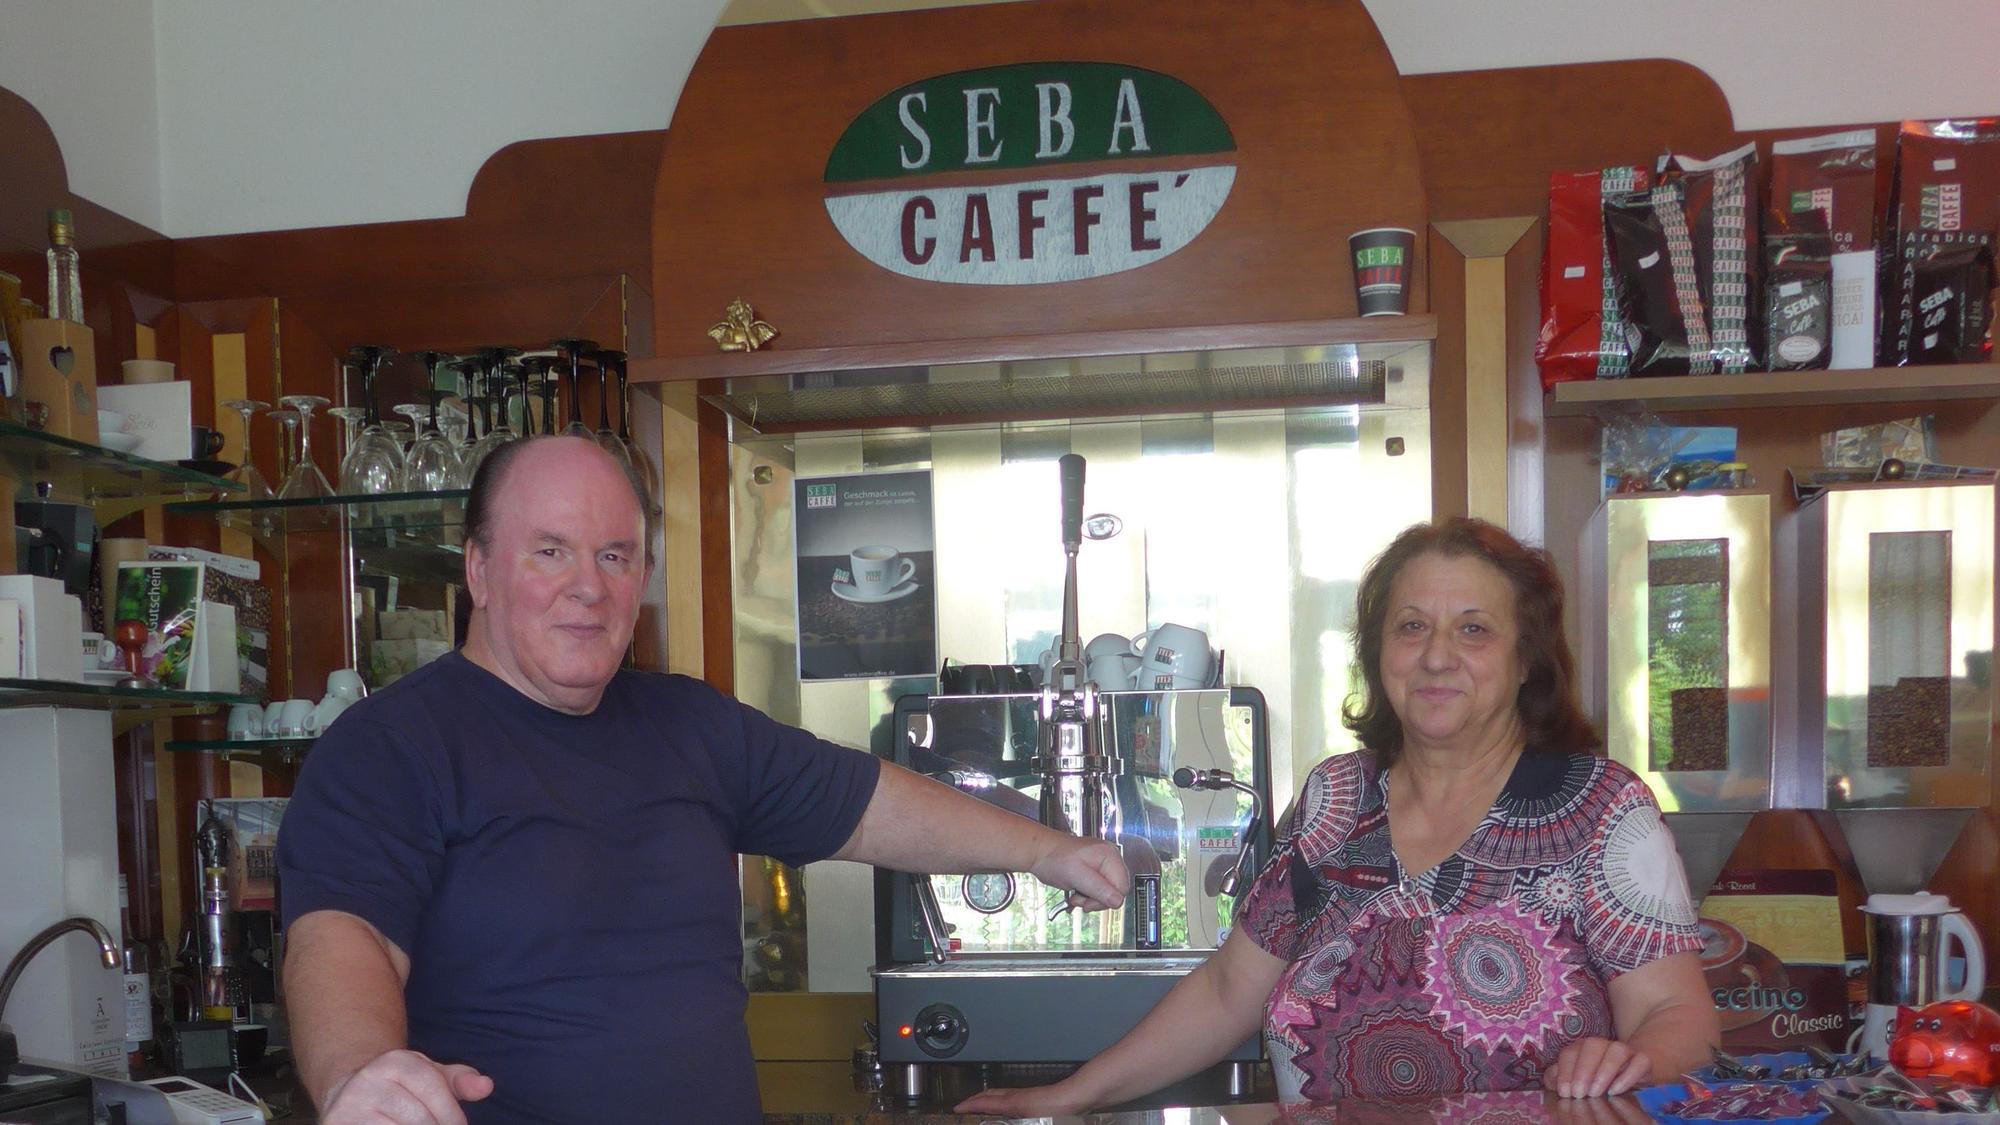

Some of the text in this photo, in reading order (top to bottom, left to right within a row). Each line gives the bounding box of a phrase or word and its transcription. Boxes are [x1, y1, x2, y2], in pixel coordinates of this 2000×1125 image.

[899, 78, 1151, 170] SEBA
[1922, 186, 1939, 230] SEBA
[1905, 232, 1988, 245] Arabica
[1357, 248, 1401, 267] SEBA
[1783, 294, 1820, 319] SEBA
[1920, 288, 1953, 313] SEBA
[843, 490, 889, 500] Geschmack
[148, 567, 161, 633] Gutschein
[1771, 1013, 1844, 1039] Classic
